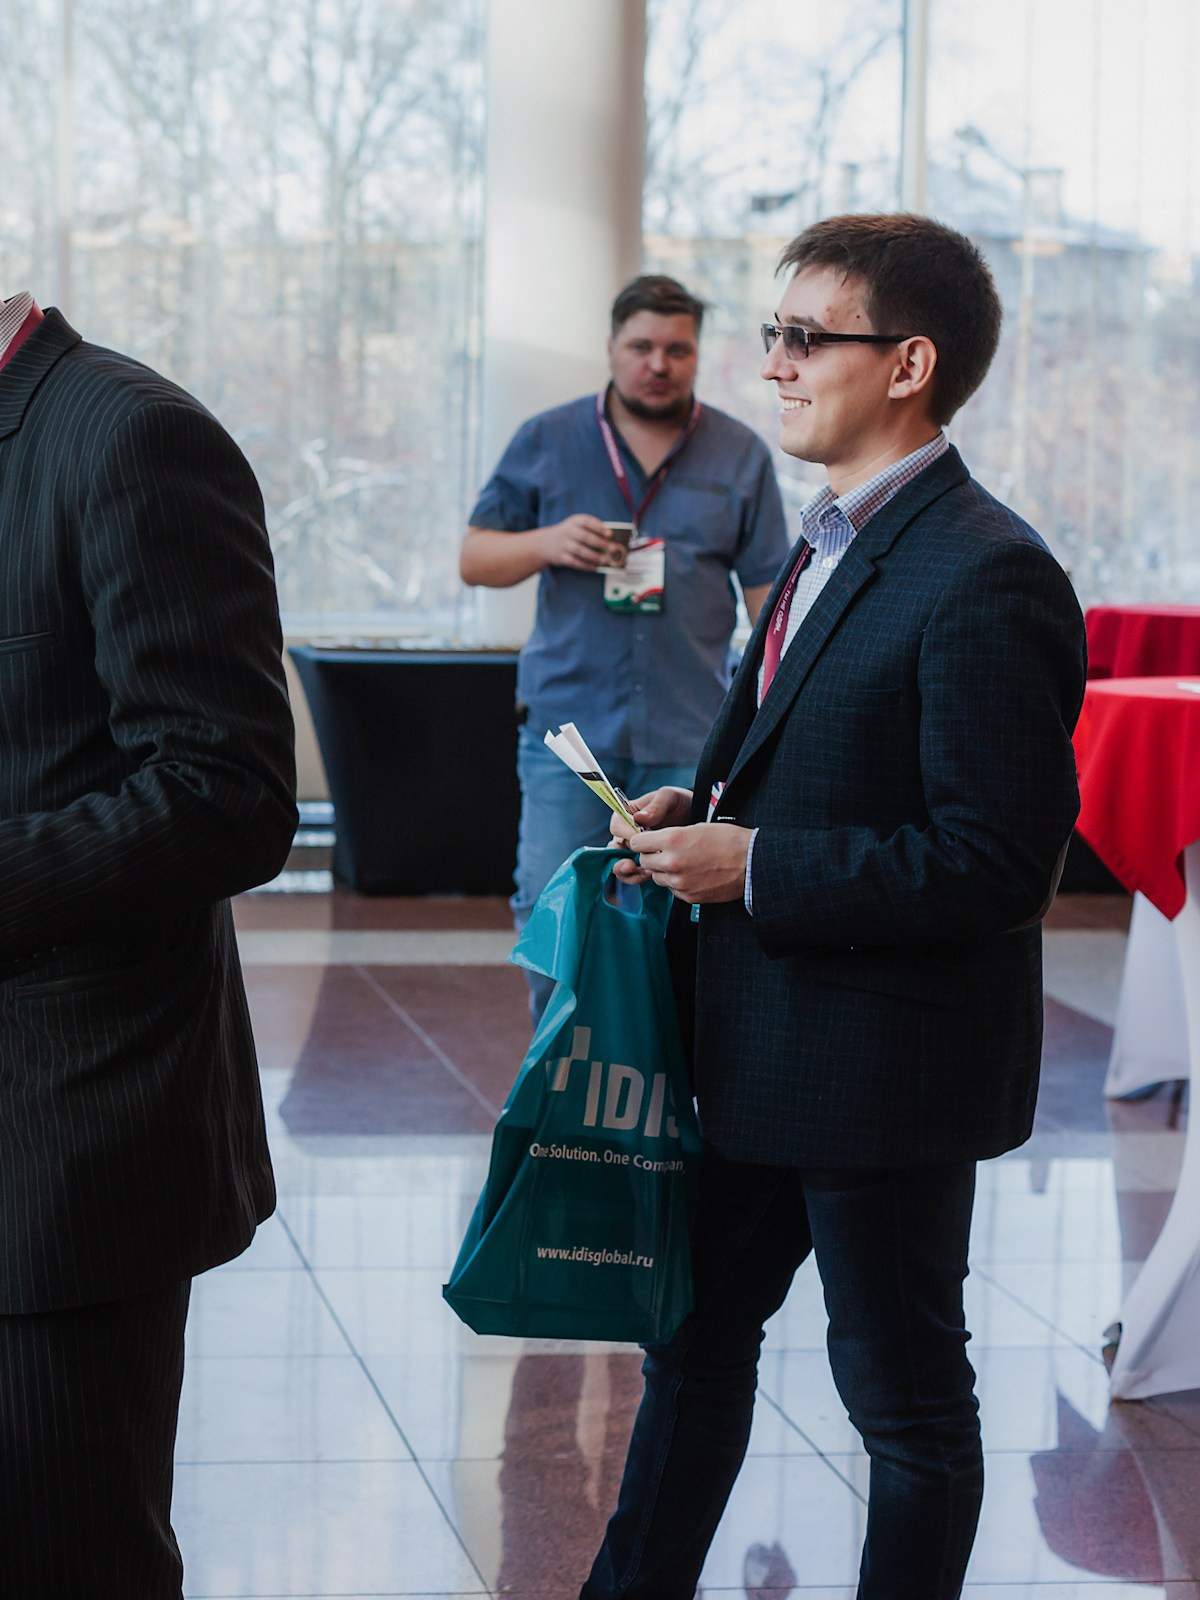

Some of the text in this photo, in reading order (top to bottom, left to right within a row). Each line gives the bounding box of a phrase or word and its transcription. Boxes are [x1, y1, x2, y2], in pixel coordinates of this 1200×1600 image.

[530, 1143, 685, 1175] One Solution. One Compan
[537, 1247, 653, 1268] www.idisglobal.ru
